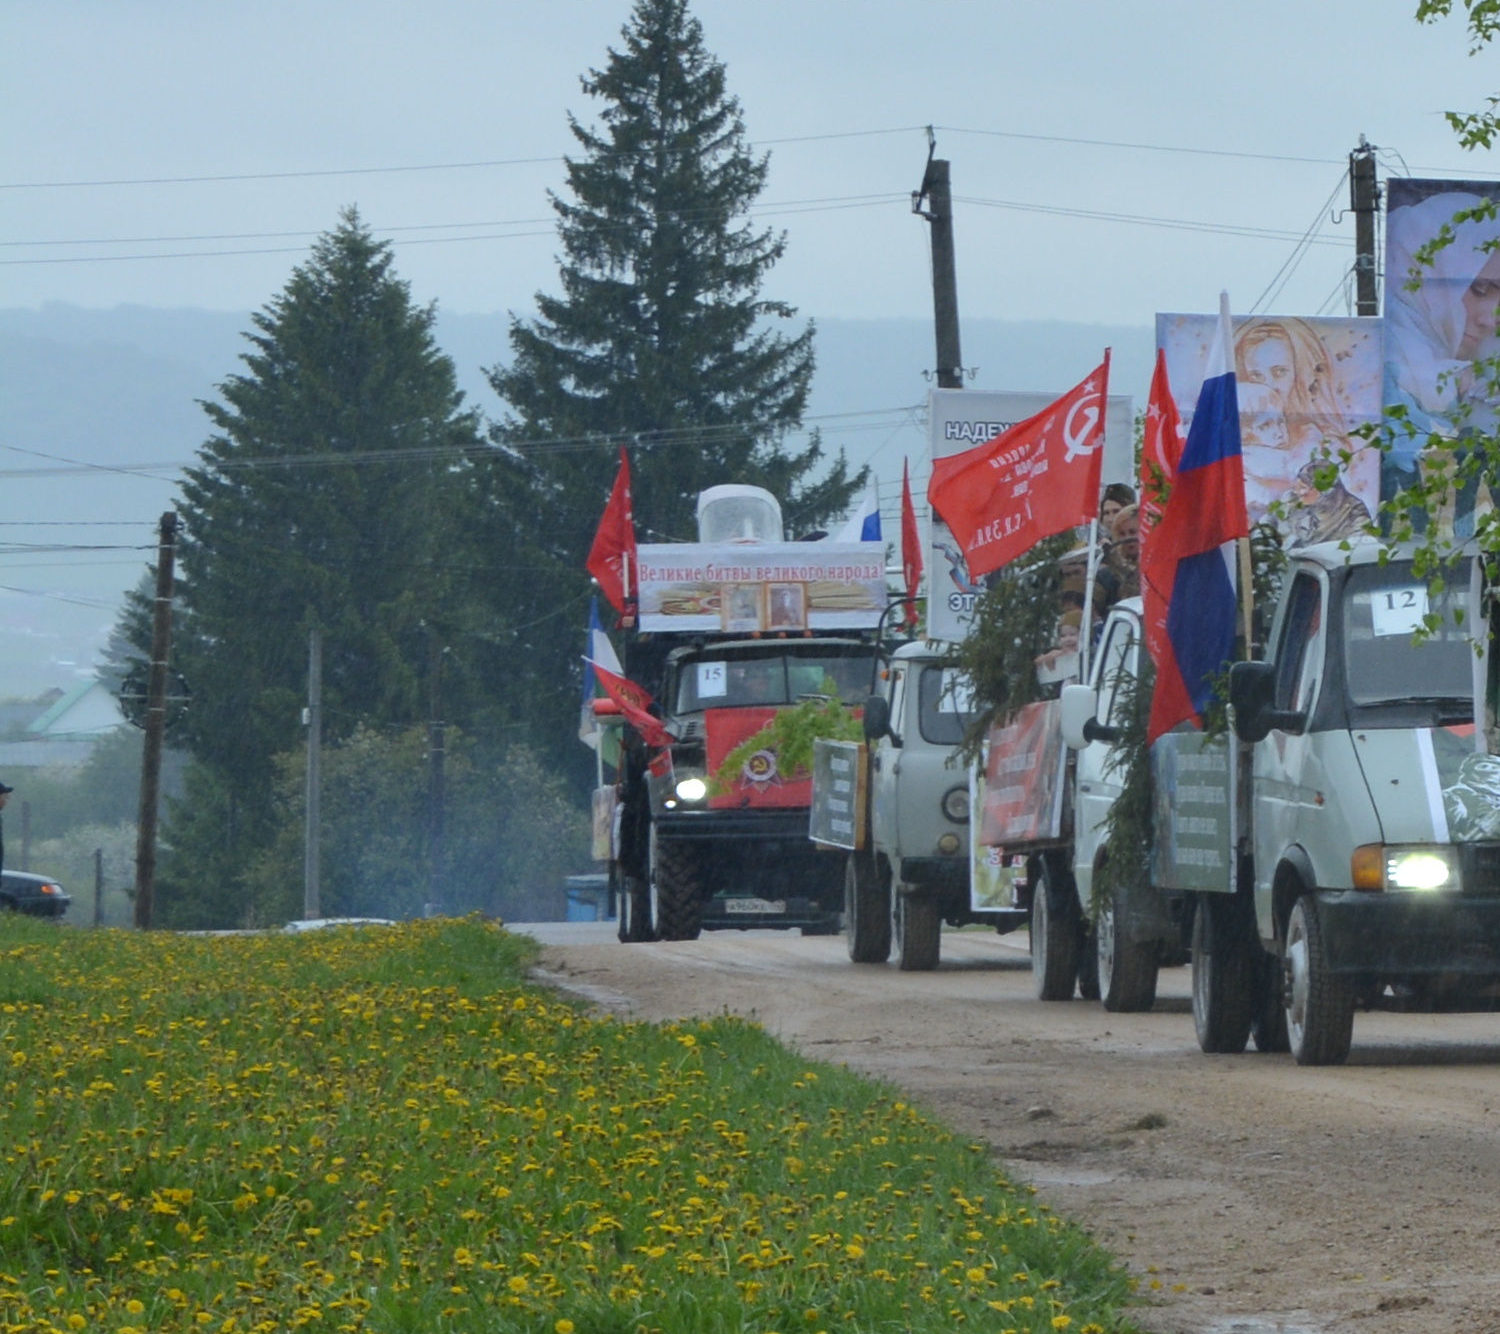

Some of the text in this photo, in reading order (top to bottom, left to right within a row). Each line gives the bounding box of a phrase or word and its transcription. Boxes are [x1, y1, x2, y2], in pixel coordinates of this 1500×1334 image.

[640, 565, 701, 582] Великие
[706, 564, 750, 581] битвы
[757, 566, 823, 581] великого
[829, 563, 884, 585] народа!
[1384, 590, 1417, 610] 12
[705, 668, 721, 680] 15
